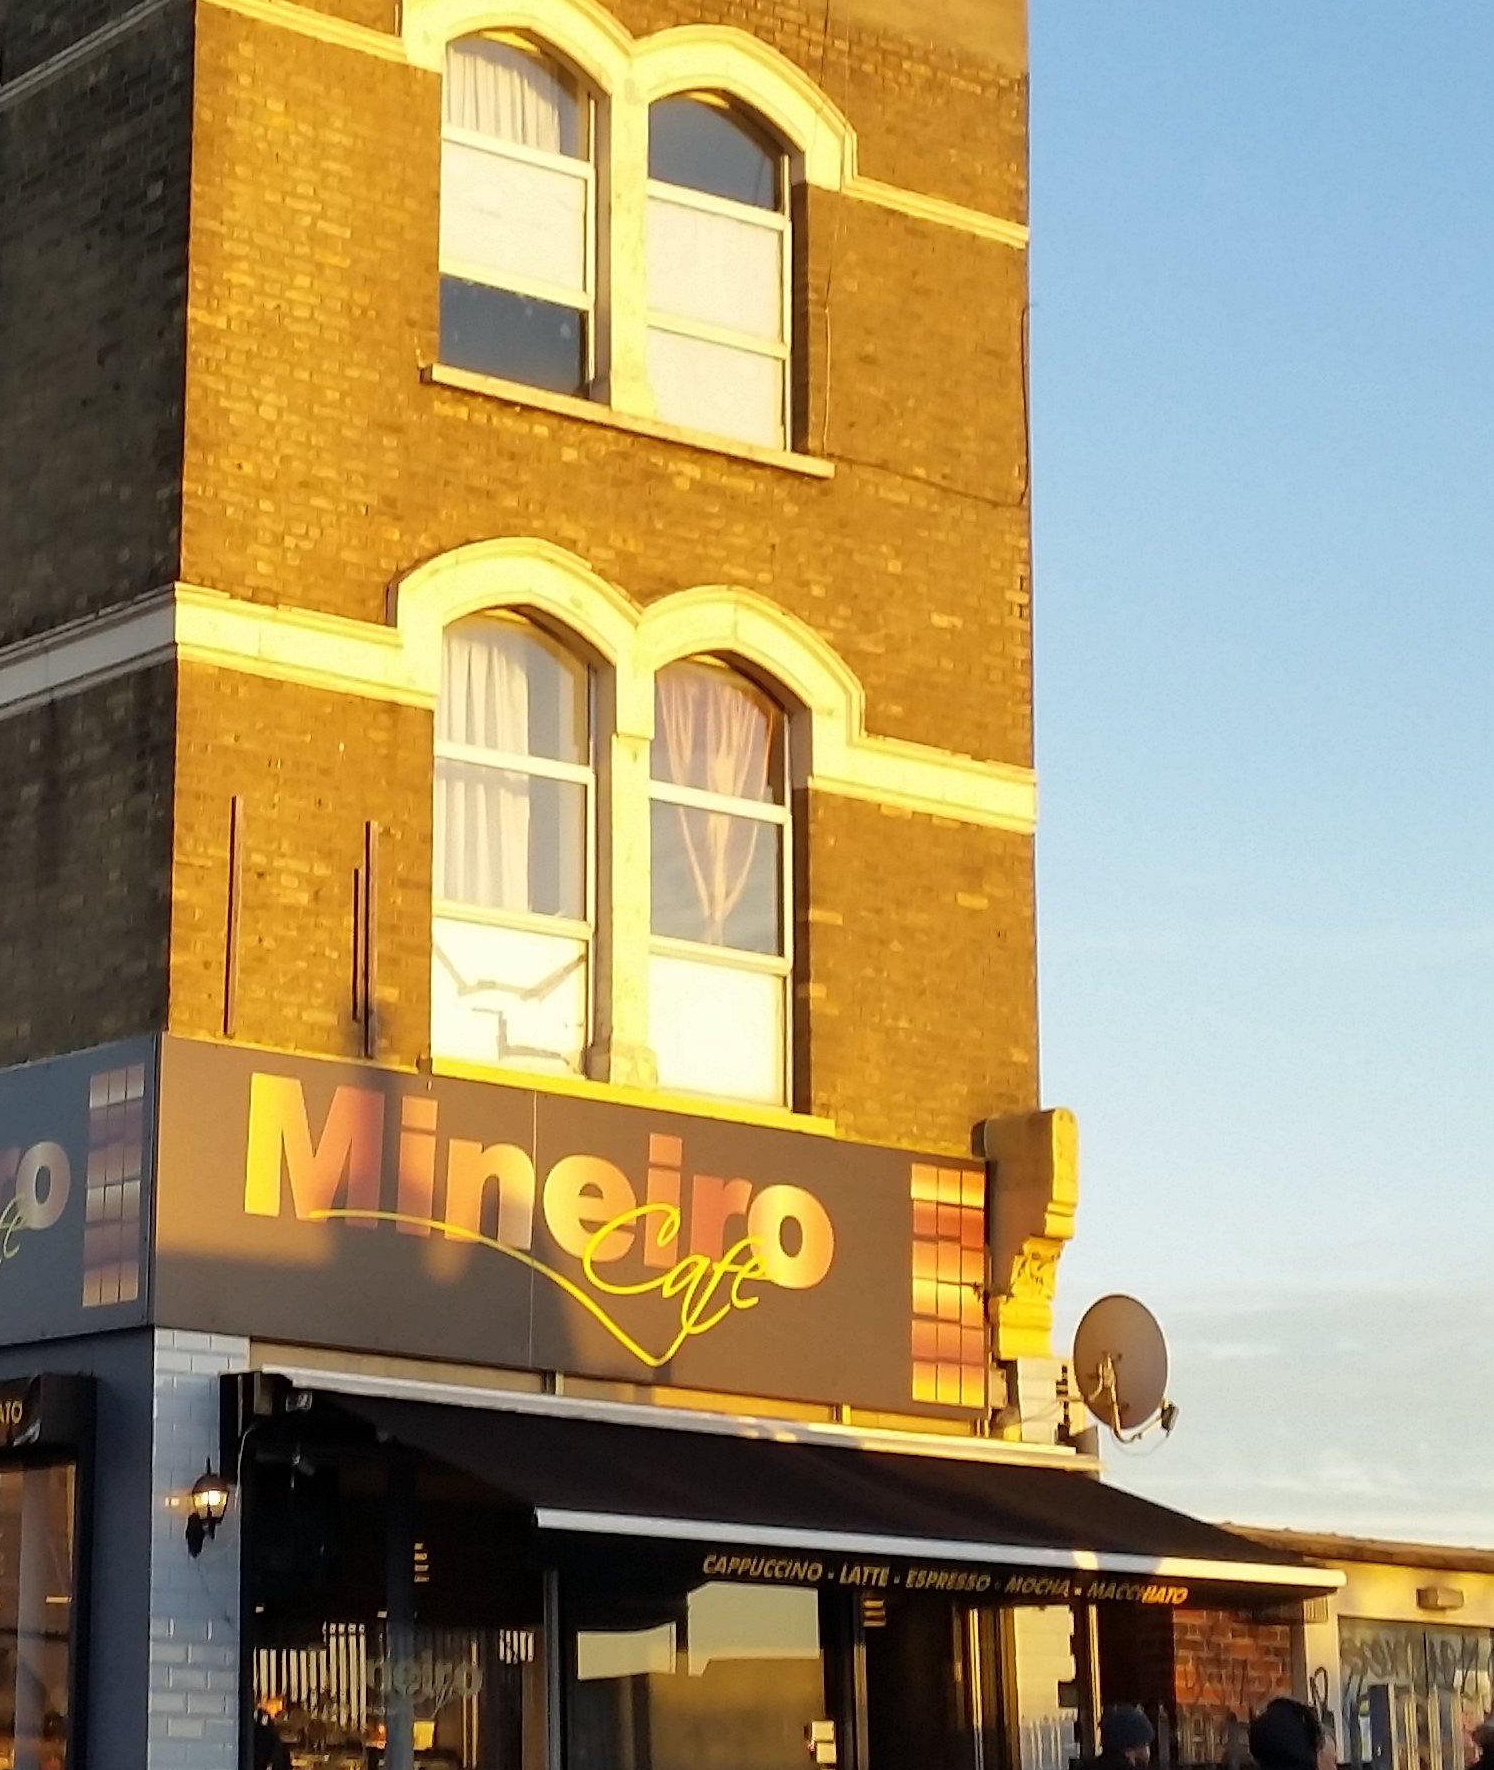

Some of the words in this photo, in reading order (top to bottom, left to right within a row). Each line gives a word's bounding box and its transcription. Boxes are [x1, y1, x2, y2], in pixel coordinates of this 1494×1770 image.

[244, 1072, 835, 1290] Mineiro
[582, 1202, 768, 1336] Cafe
[702, 1554, 823, 1582] CAPPUCCINO
[839, 1564, 890, 1588] LATTE
[906, 1567, 992, 1593] ESPRESSO
[1006, 1574, 1070, 1599] MOCHA
[1087, 1581, 1189, 1605] MACCHIATO
